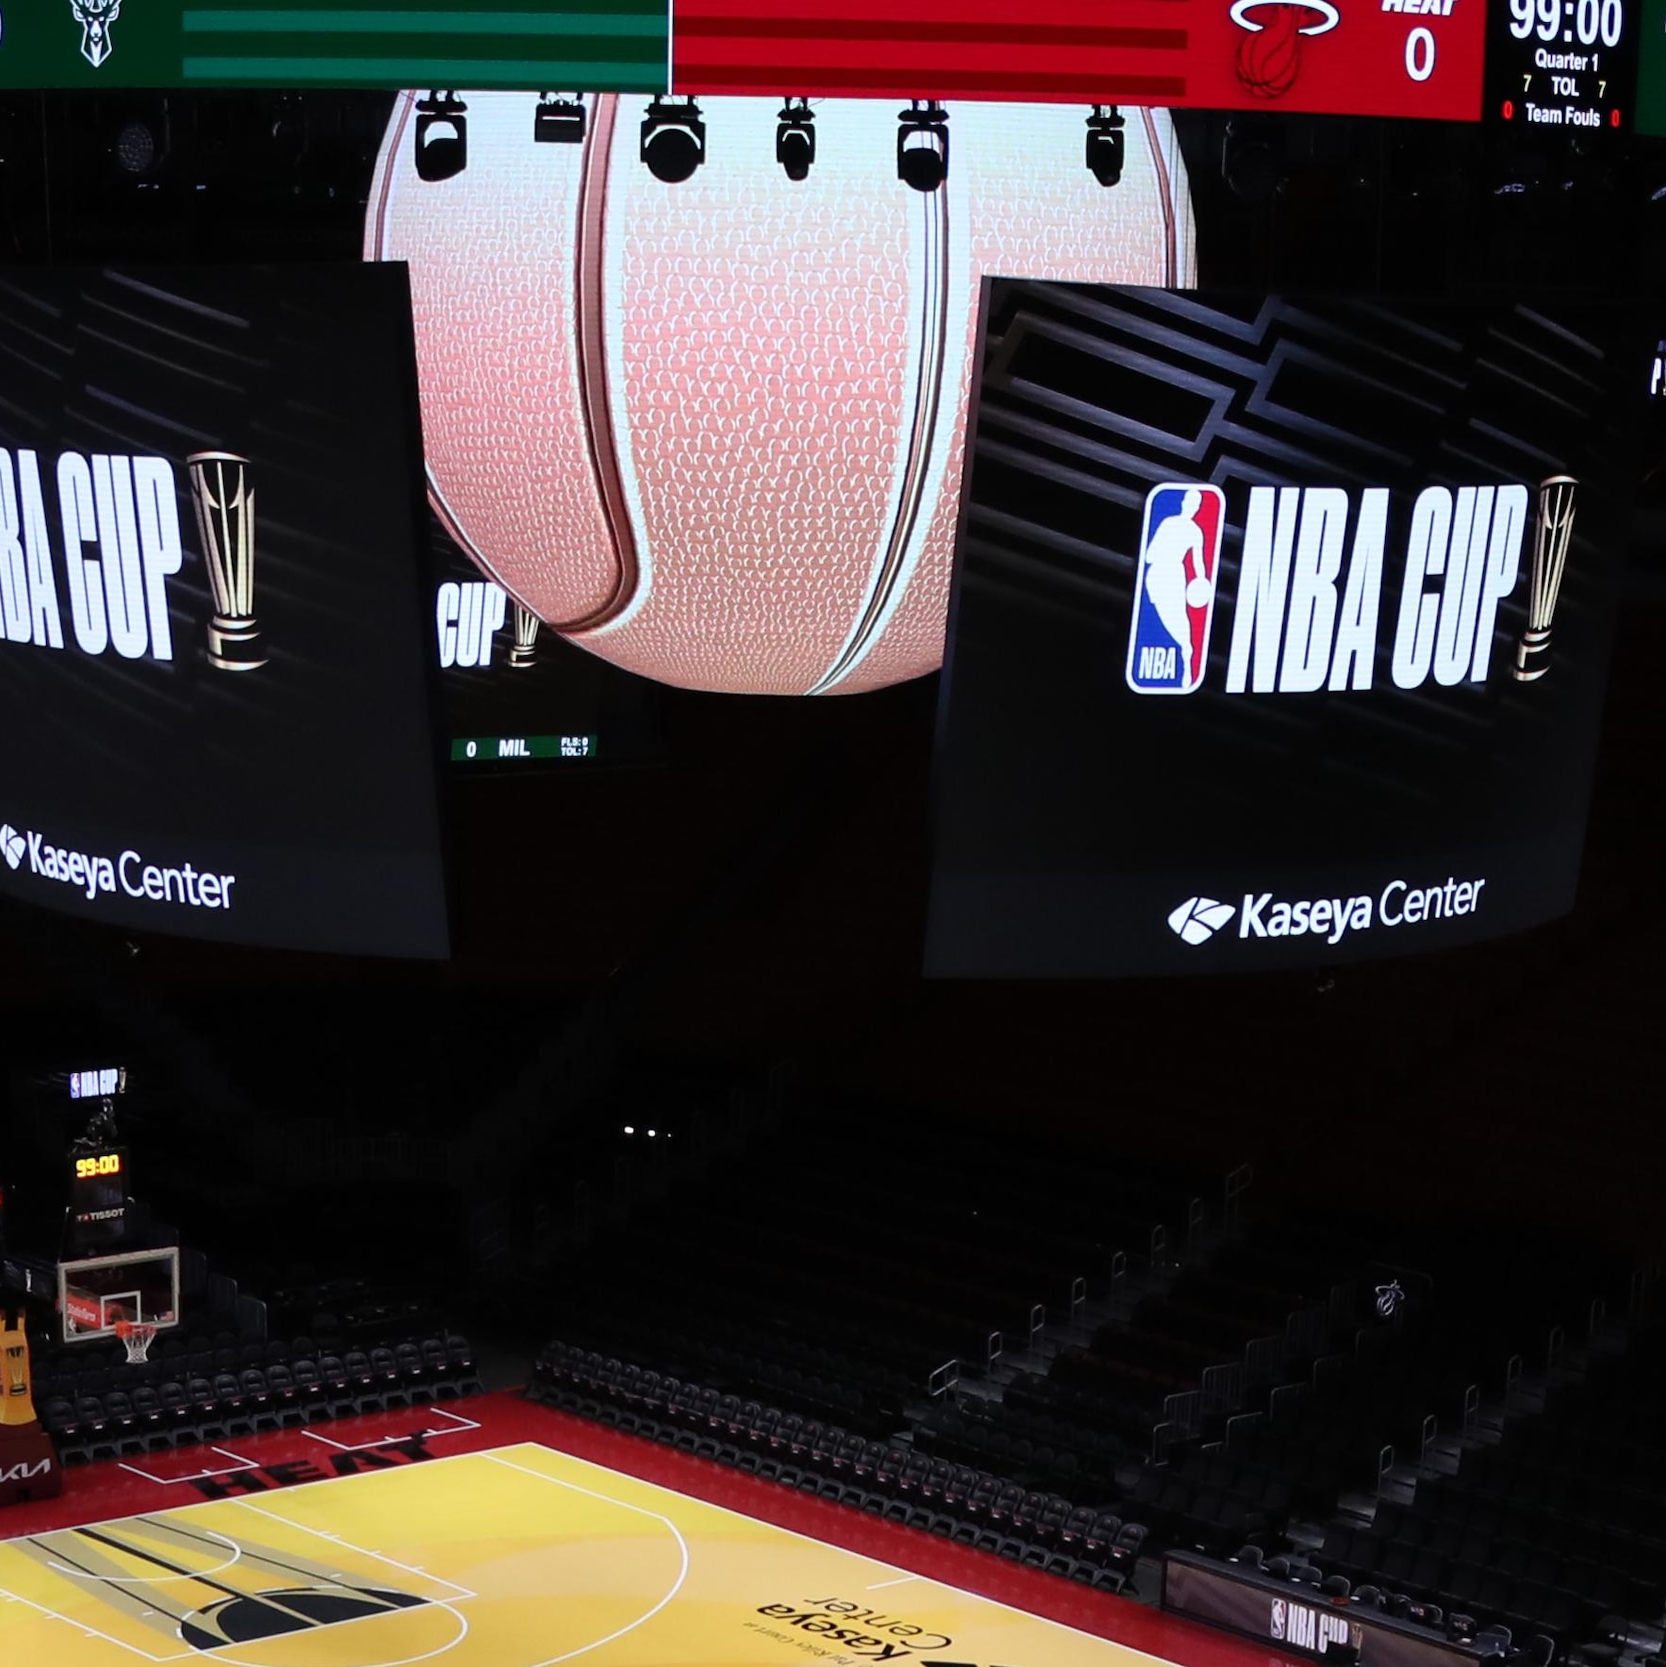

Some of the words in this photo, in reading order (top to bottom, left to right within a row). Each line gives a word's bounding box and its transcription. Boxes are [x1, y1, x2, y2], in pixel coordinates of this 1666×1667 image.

[1509, 0, 1622, 47] 99:00
[1405, 27, 1435, 82] 0
[1535, 48, 1588, 71] Quarter
[1592, 54, 1599, 71] 1
[1523, 74, 1532, 92] 7
[1551, 76, 1580, 97] TOL
[1598, 81, 1606, 98] 7
[1502, 100, 1514, 119] 0
[1526, 103, 1562, 124] Team
[1565, 106, 1601, 127] Fouls
[1610, 109, 1620, 127] 0
[57, 451, 182, 661] CUP
[1225, 486, 1390, 694] NBA
[1391, 484, 1528, 690] CUP
[436, 582, 507, 668] CUP
[1138, 646, 1176, 681] NBA
[466, 741, 477, 757] 0
[499, 739, 530, 757] MIL
[27, 831, 116, 899] Kaseya
[119, 850, 235, 908] Center
[1239, 893, 1372, 945] Kaseya
[1379, 877, 1485, 927] Center
[76, 1154, 120, 1179] 99:00
[757, 1603, 912, 1662] Kaseya
[803, 1596, 952, 1650] Center
[1287, 1602, 1315, 1650] NBA
